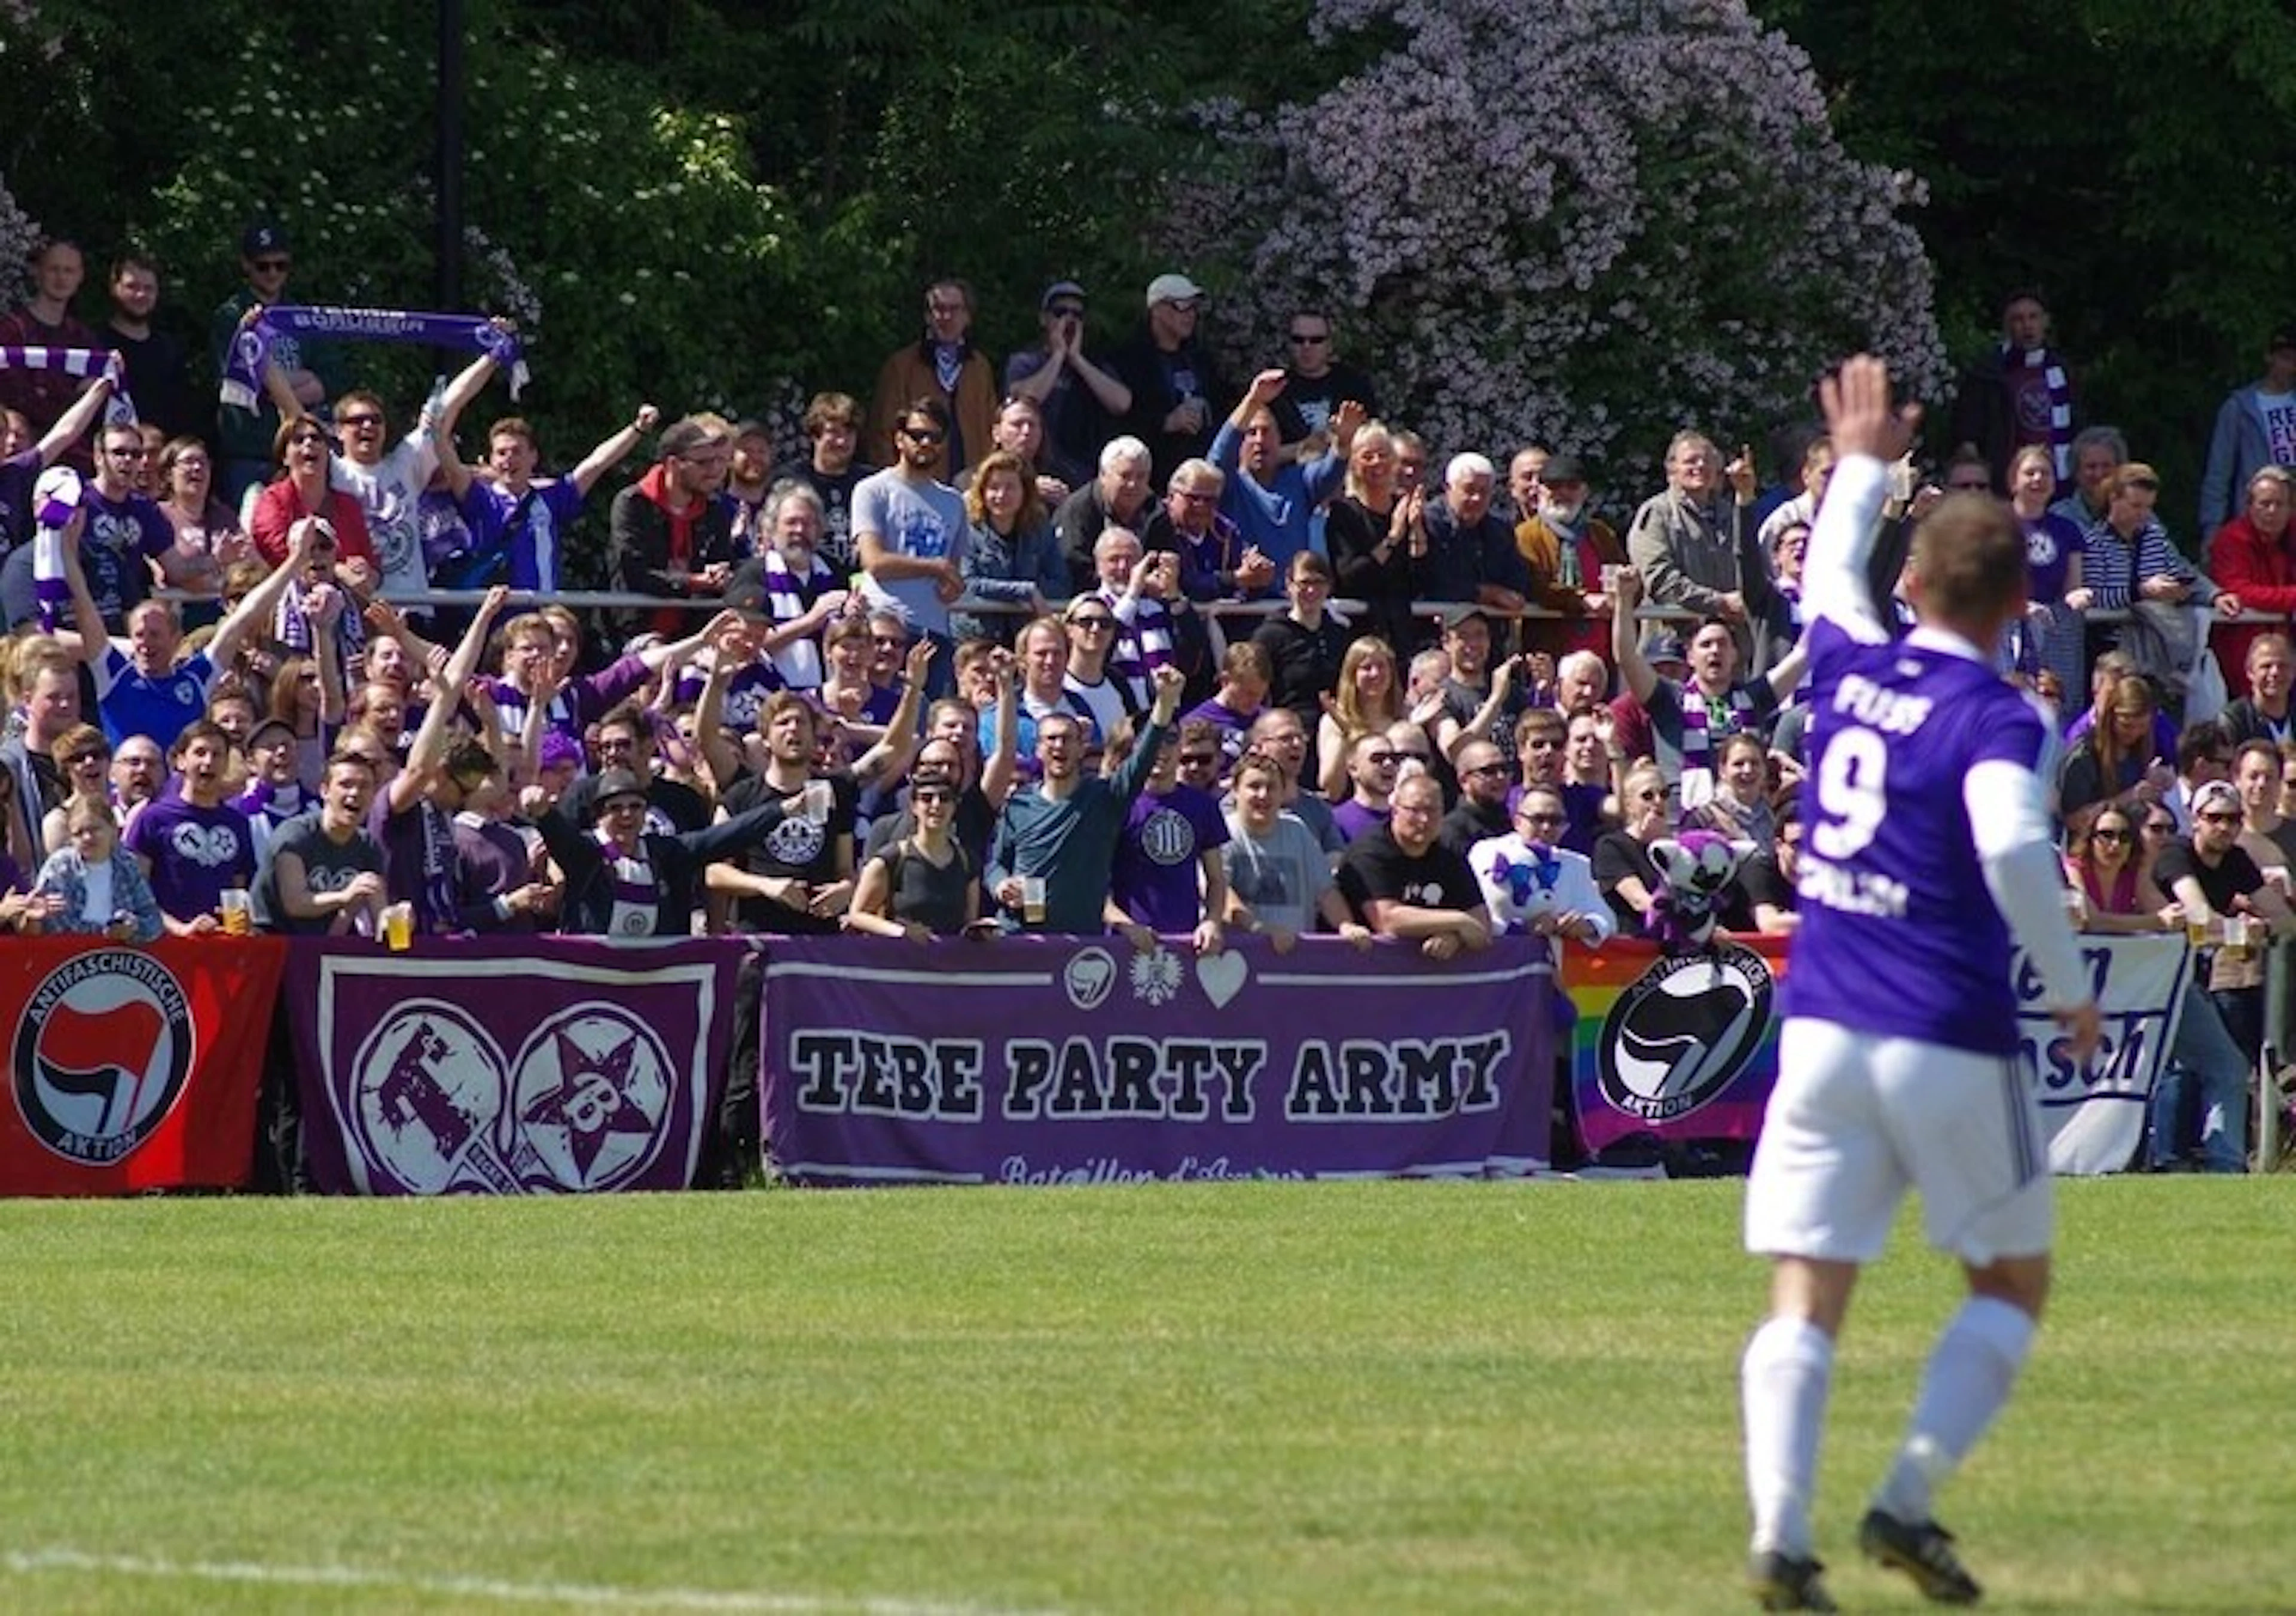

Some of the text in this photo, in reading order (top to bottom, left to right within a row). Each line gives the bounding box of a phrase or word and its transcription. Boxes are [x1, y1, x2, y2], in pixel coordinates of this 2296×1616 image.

[1812, 724, 1887, 860] 9
[30, 954, 184, 1024] ANTIFASCHISTISCHE
[791, 1029, 1510, 1123] TEBE PARTY ARMY
[1621, 1094, 1693, 1118] AKTION
[56, 1129, 138, 1159] AKTION
